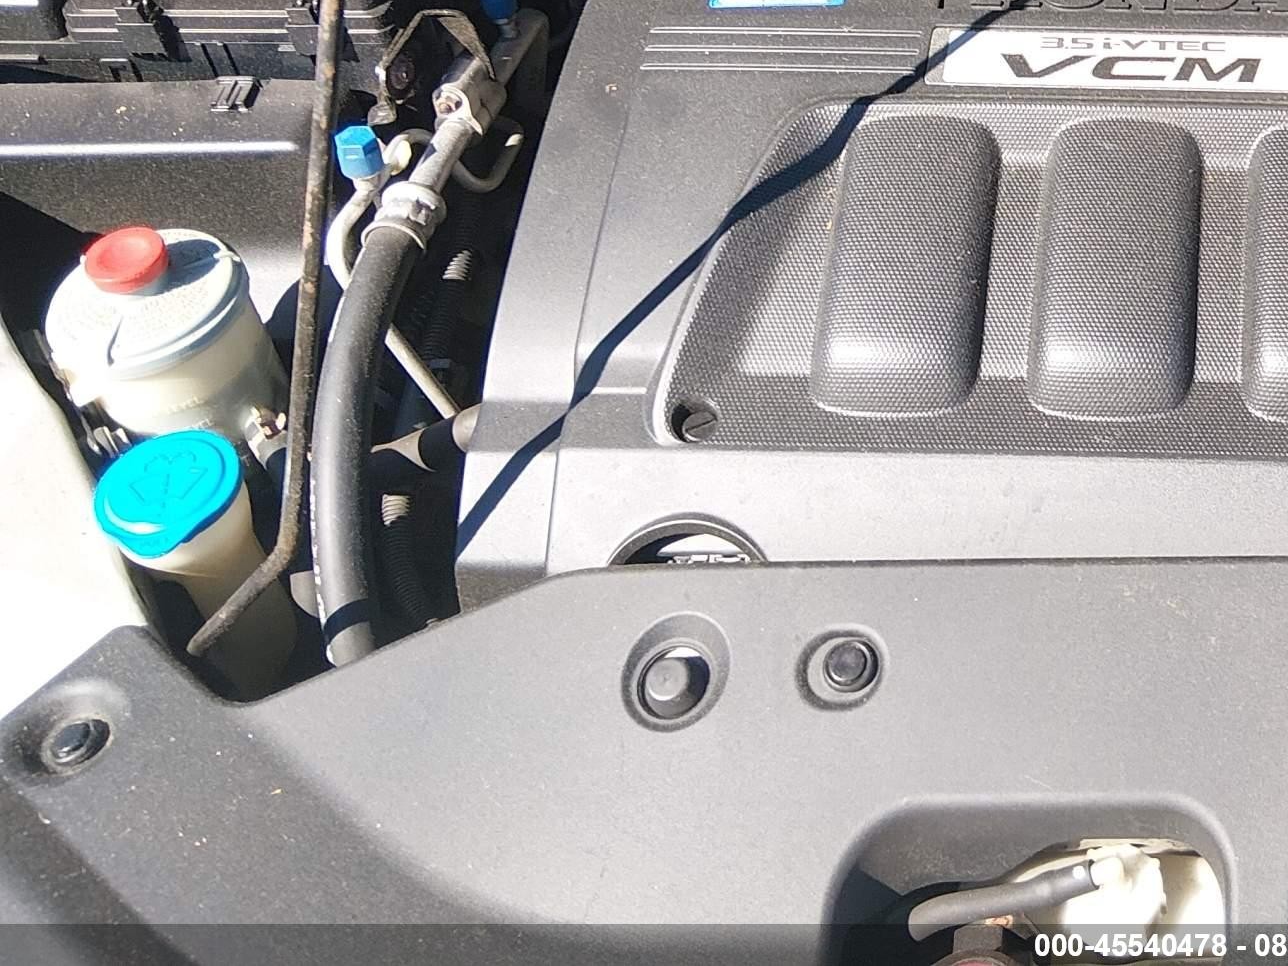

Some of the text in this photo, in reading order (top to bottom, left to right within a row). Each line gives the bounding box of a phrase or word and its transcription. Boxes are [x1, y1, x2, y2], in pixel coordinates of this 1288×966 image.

[1041, 37, 1226, 52] 3.5 i-VTEC
[1002, 54, 1261, 83] VCM
